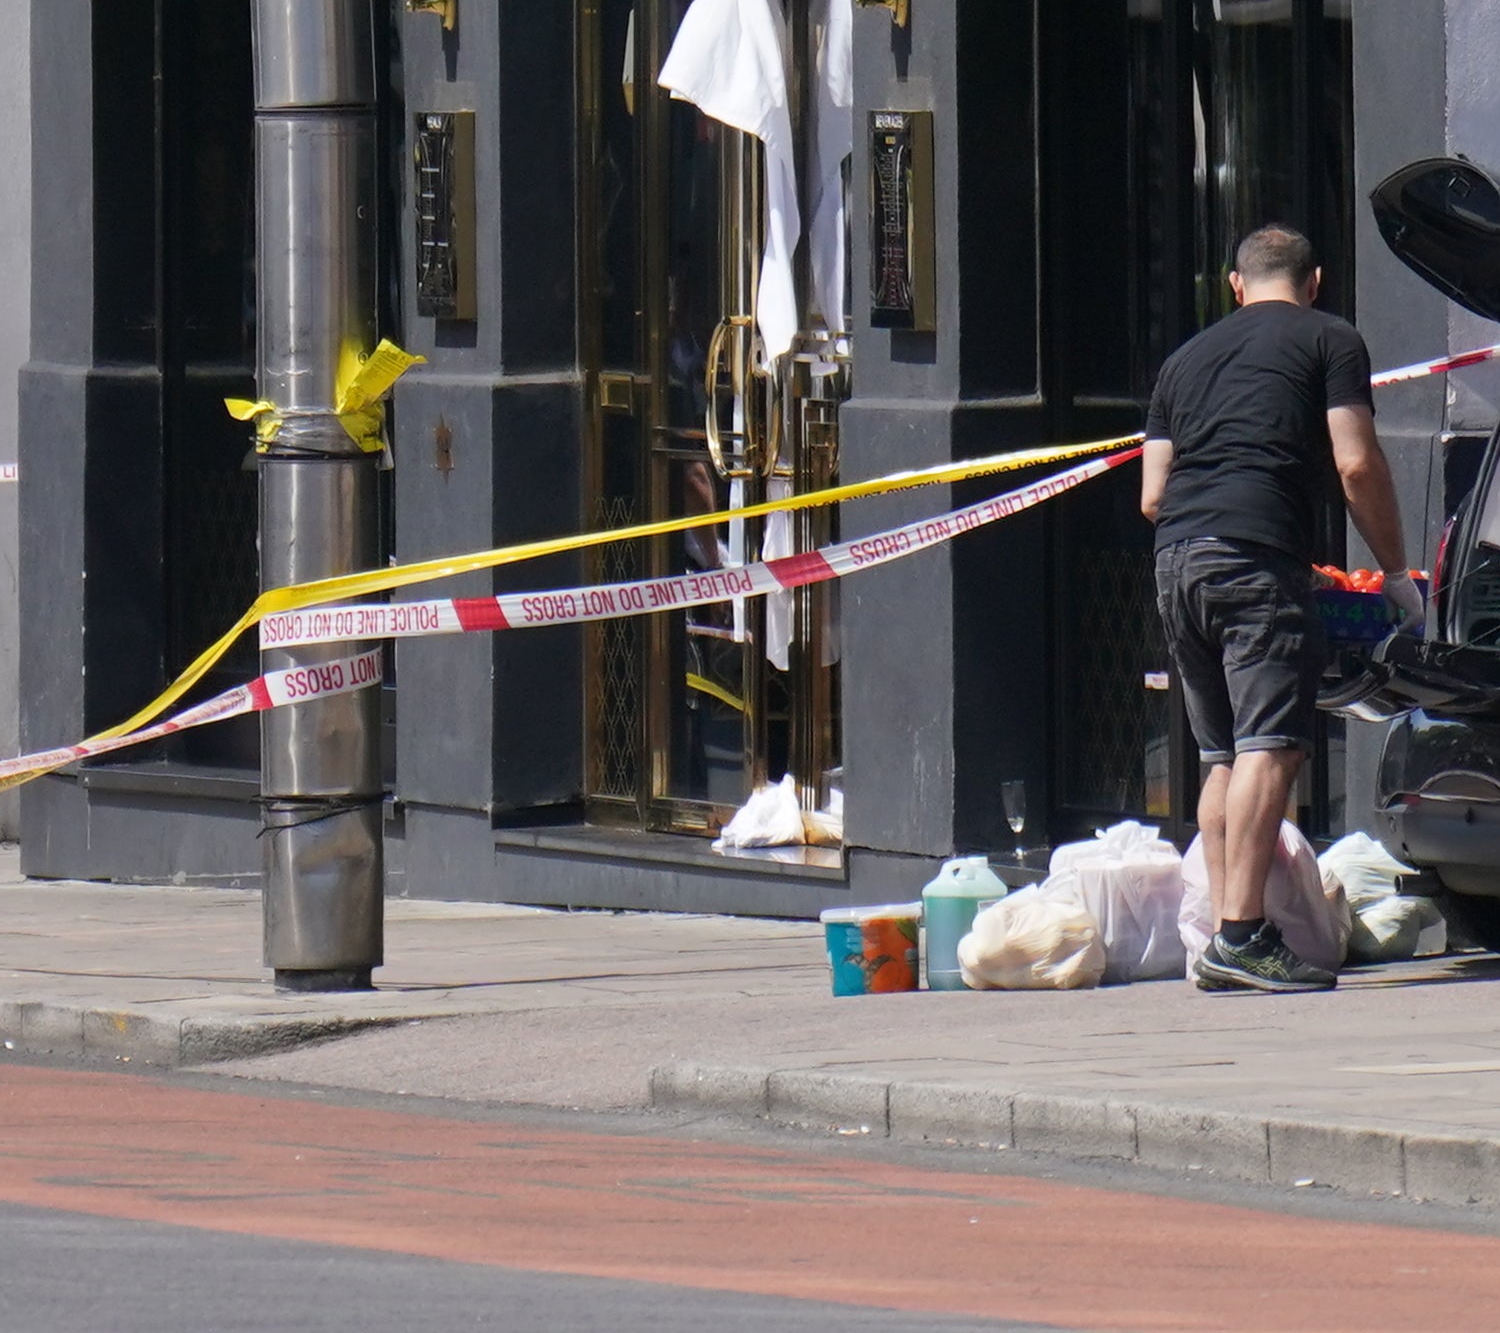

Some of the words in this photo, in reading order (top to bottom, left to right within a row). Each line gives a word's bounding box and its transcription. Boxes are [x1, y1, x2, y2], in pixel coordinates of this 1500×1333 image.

[984, 490, 1024, 524] LINE
[849, 532, 901, 565] CROSS
[620, 583, 643, 609] DO
[645, 578, 685, 608] LINE
[697, 569, 752, 600] POLICE
[522, 592, 576, 623] CROSS
[582, 588, 616, 616] NOT
[264, 616, 303, 643] CROSS
[305, 614, 331, 639] NOT
[333, 611, 351, 636] DO
[356, 607, 386, 634] LINE
[389, 604, 439, 631] POLICE
[285, 664, 344, 699] CROSS
[346, 654, 376, 684] NOT
